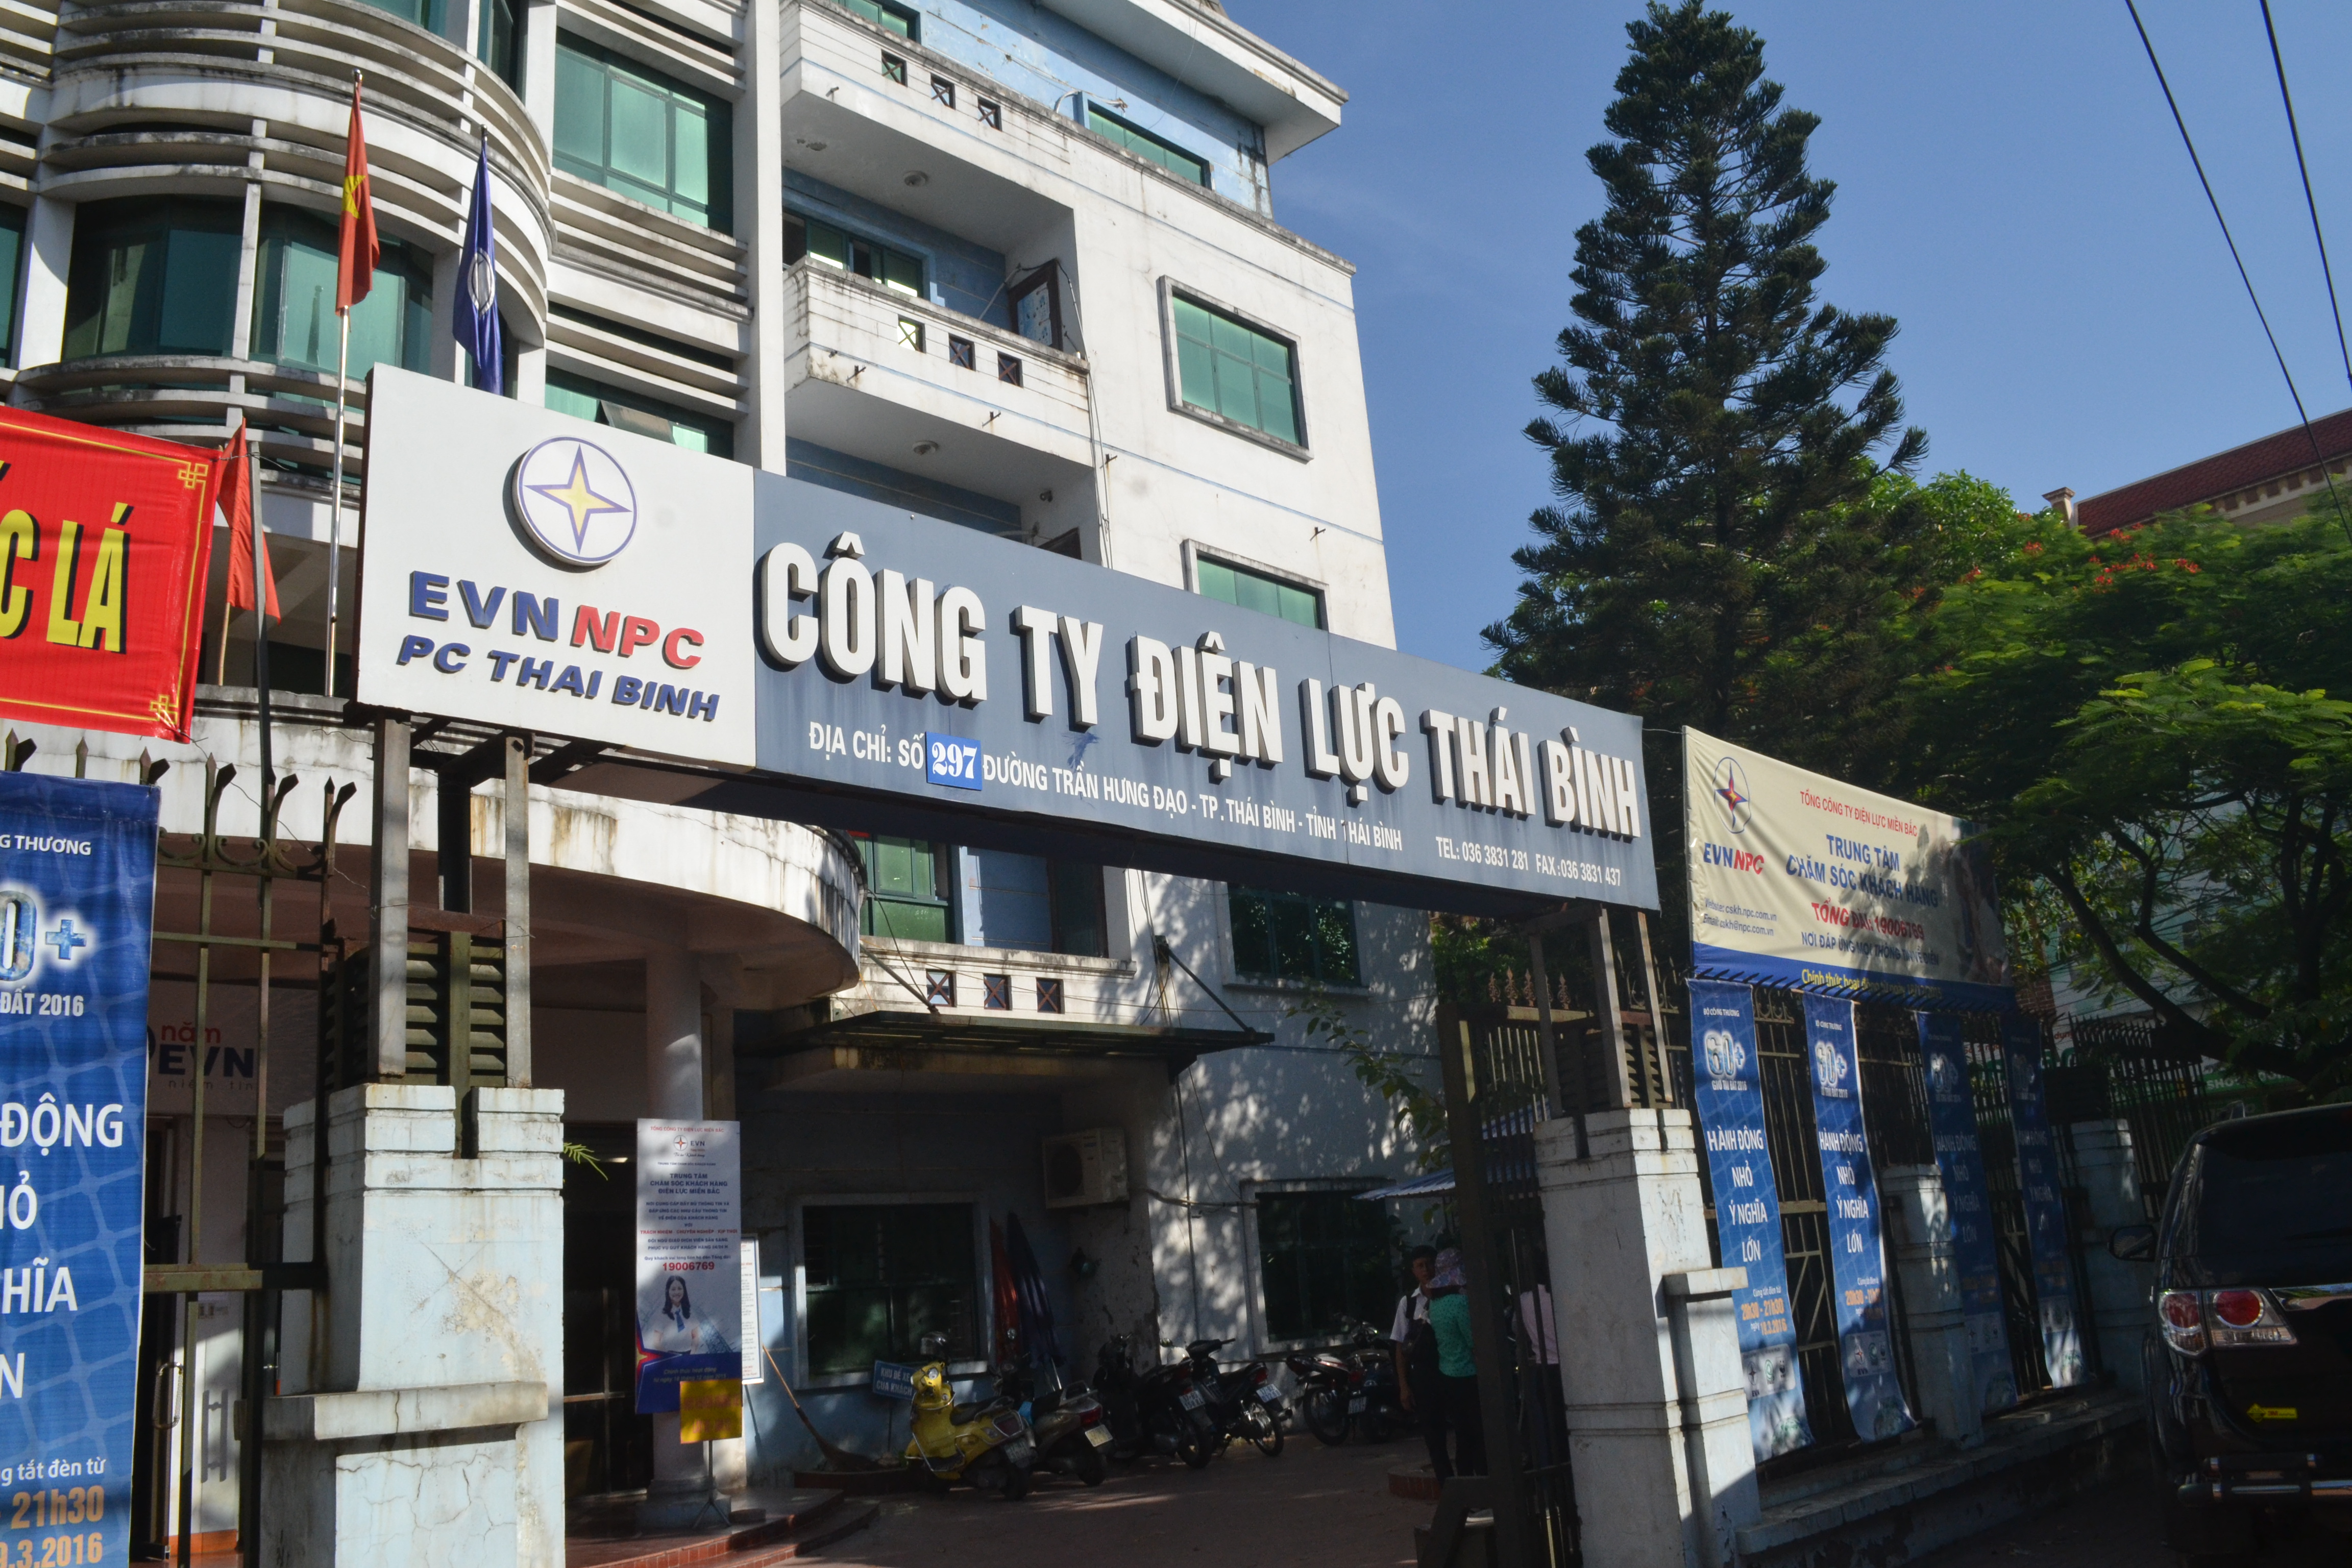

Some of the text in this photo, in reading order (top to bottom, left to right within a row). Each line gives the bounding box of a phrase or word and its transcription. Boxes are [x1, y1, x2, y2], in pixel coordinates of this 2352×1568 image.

[46, 502, 130, 652] LÁ
[396, 634, 720, 722] PC THAI BINH
[762, 531, 1640, 839] CÔNG TY ĐIỆN LỰC THÁI BÌNH
[809, 721, 846, 761] ĐỊA
[852, 724, 891, 763] CHỈ:
[898, 732, 924, 769] SỐ
[932, 741, 977, 779] 297
[983, 751, 1047, 791] ĐƯỜNG
[1052, 761, 1098, 799] TRẦN
[1104, 777, 1149, 807] HƯNG
[1153, 786, 1187, 819] ĐẠO
[1226, 796, 1259, 827] THÁI
[1263, 800, 1295, 833] BÌNH
[1306, 805, 1336, 840] TỈNH
[1374, 821, 1403, 851] BÌNH
[1822, 797, 1843, 815] CÔNG
[1845, 805, 1853, 818] TY
[14, 834, 92, 856] THƯƠNG
[1826, 834, 1900, 872] TRUNG TÂM
[1435, 836, 1460, 860] TEL:
[1462, 842, 1482, 863] 036
[1484, 845, 1509, 867] 3831
[1511, 850, 1528, 870] 281
[1580, 863, 1603, 884] 3831
[1605, 867, 1621, 887] 437
[1786, 854, 1826, 884] CHĂM
[1830, 863, 1856, 890] SÓC
[1859, 872, 1902, 900] KHÁCH
[1811, 897, 1849, 926] TỔNG
[1874, 916, 1925, 941] 19006769
[1801, 932, 1817, 946] NƠI
[1819, 933, 1836, 949] ĐÁP
[39, 993, 84, 1017] 2016
[0, 1092, 124, 1156] ĐỘNG
[1707, 1125, 1764, 1154] HÀNH ĐỘNG
[1819, 1128, 1863, 1155] HÀNH ĐỘNG
[1731, 1160, 1753, 1187] NHỎ
[1836, 1161, 1855, 1185] NHỎ
[1728, 1197, 1768, 1226] Ý NGHĨA
[1843, 1195, 1869, 1219] NGHĨA
[1742, 1235, 1761, 1262] LỚN
[1847, 1229, 1863, 1253] LỚN
[663, 1261, 715, 1271] 19006769
[17, 1459, 44, 1481] tắt
[48, 1459, 82, 1478] đèn
[86, 1457, 106, 1475] từ
[11, 1485, 104, 1529] 21h30
